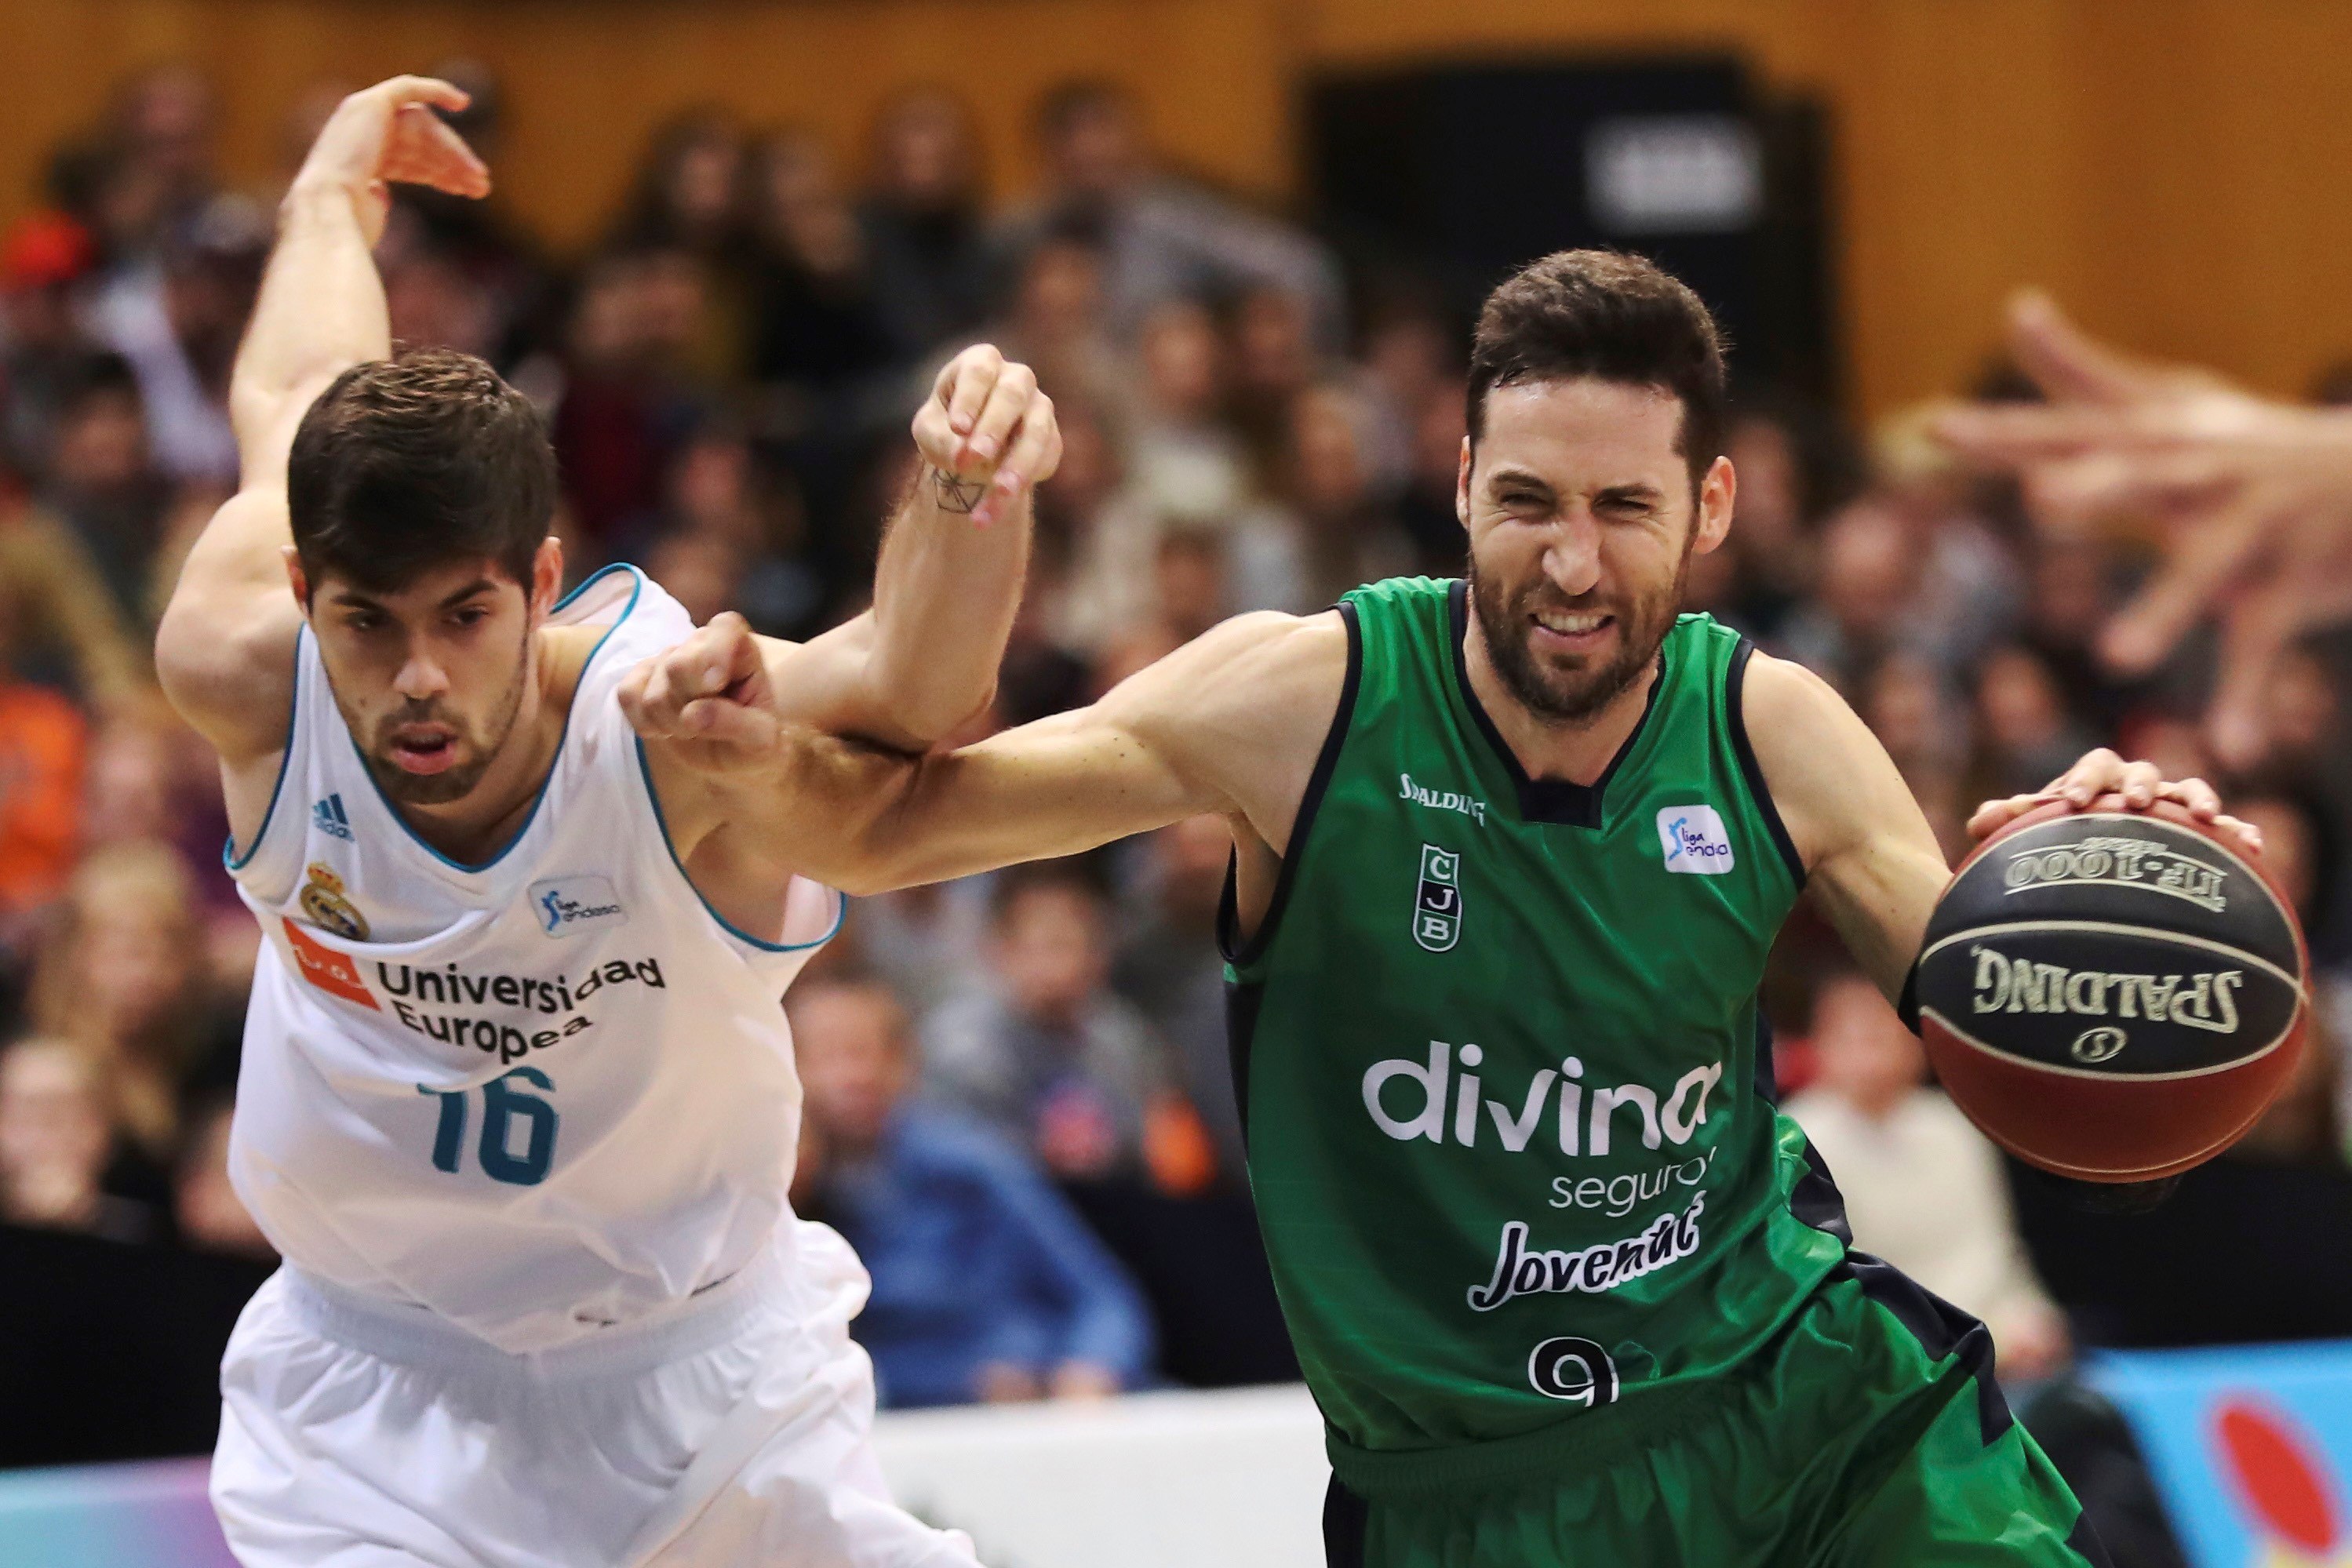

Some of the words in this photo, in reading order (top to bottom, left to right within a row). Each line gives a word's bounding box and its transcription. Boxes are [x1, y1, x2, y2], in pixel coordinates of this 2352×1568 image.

[1681, 827, 1705, 846] liga
[377, 956, 666, 1014] Universidad
[1972, 946, 2243, 1034] SPALDING
[391, 999, 594, 1064] Europea
[416, 1065, 557, 1188] 16
[1362, 1040, 1723, 1157] divina
[1527, 1336, 1620, 1408] 9
